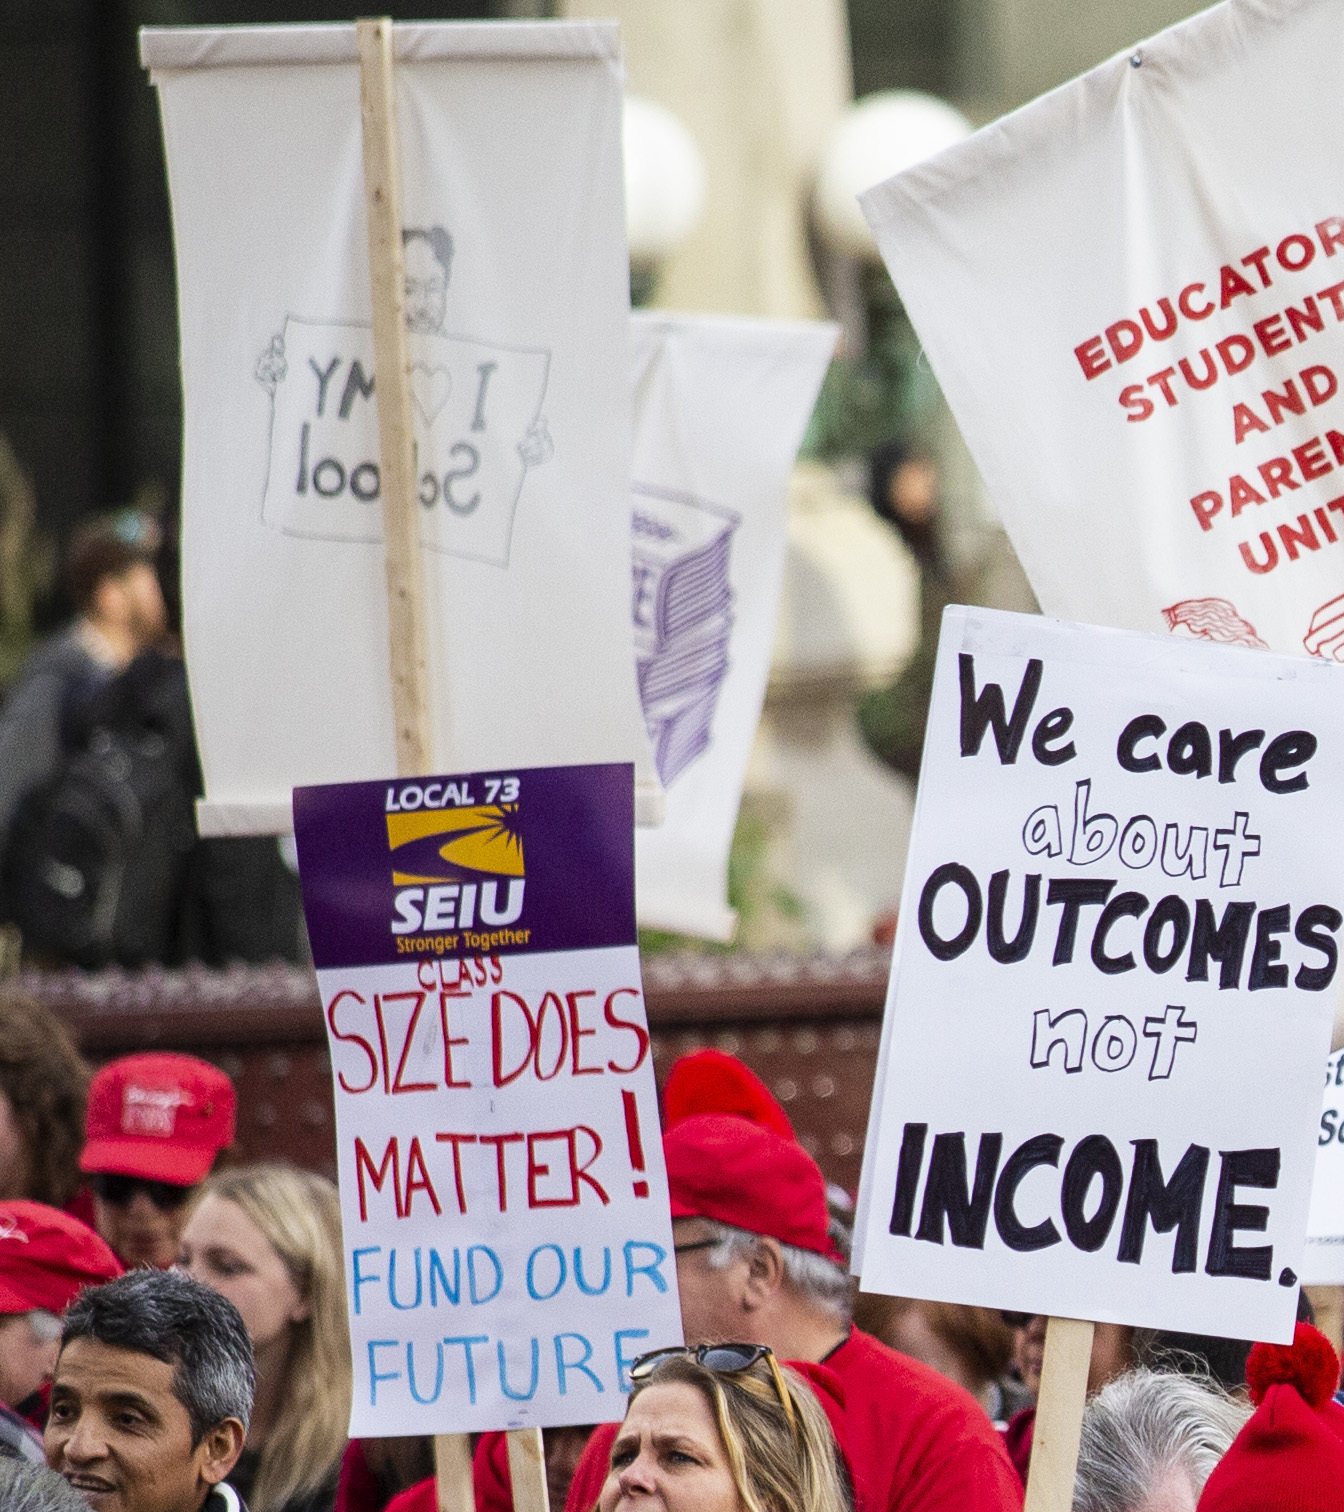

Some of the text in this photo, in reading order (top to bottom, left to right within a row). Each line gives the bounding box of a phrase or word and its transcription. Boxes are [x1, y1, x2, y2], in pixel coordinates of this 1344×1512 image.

[1233, 364, 1338, 444] AND
[958, 653, 1318, 794] We care
[386, 778, 520, 812] LOCAL 73
[1023, 779, 1260, 887] about
[391, 879, 525, 934] SEIU
[397, 929, 531, 954] Stronger Together
[918, 862, 1343, 991] OUTCOMES
[417, 955, 503, 990] CLASS
[328, 988, 650, 1094] SIZE DOES
[1030, 1004, 1197, 1081] not
[889, 1122, 1298, 1288] INCOME.
[353, 1240, 668, 1315] FUND OUR
[368, 1329, 650, 1406] FUTURE
